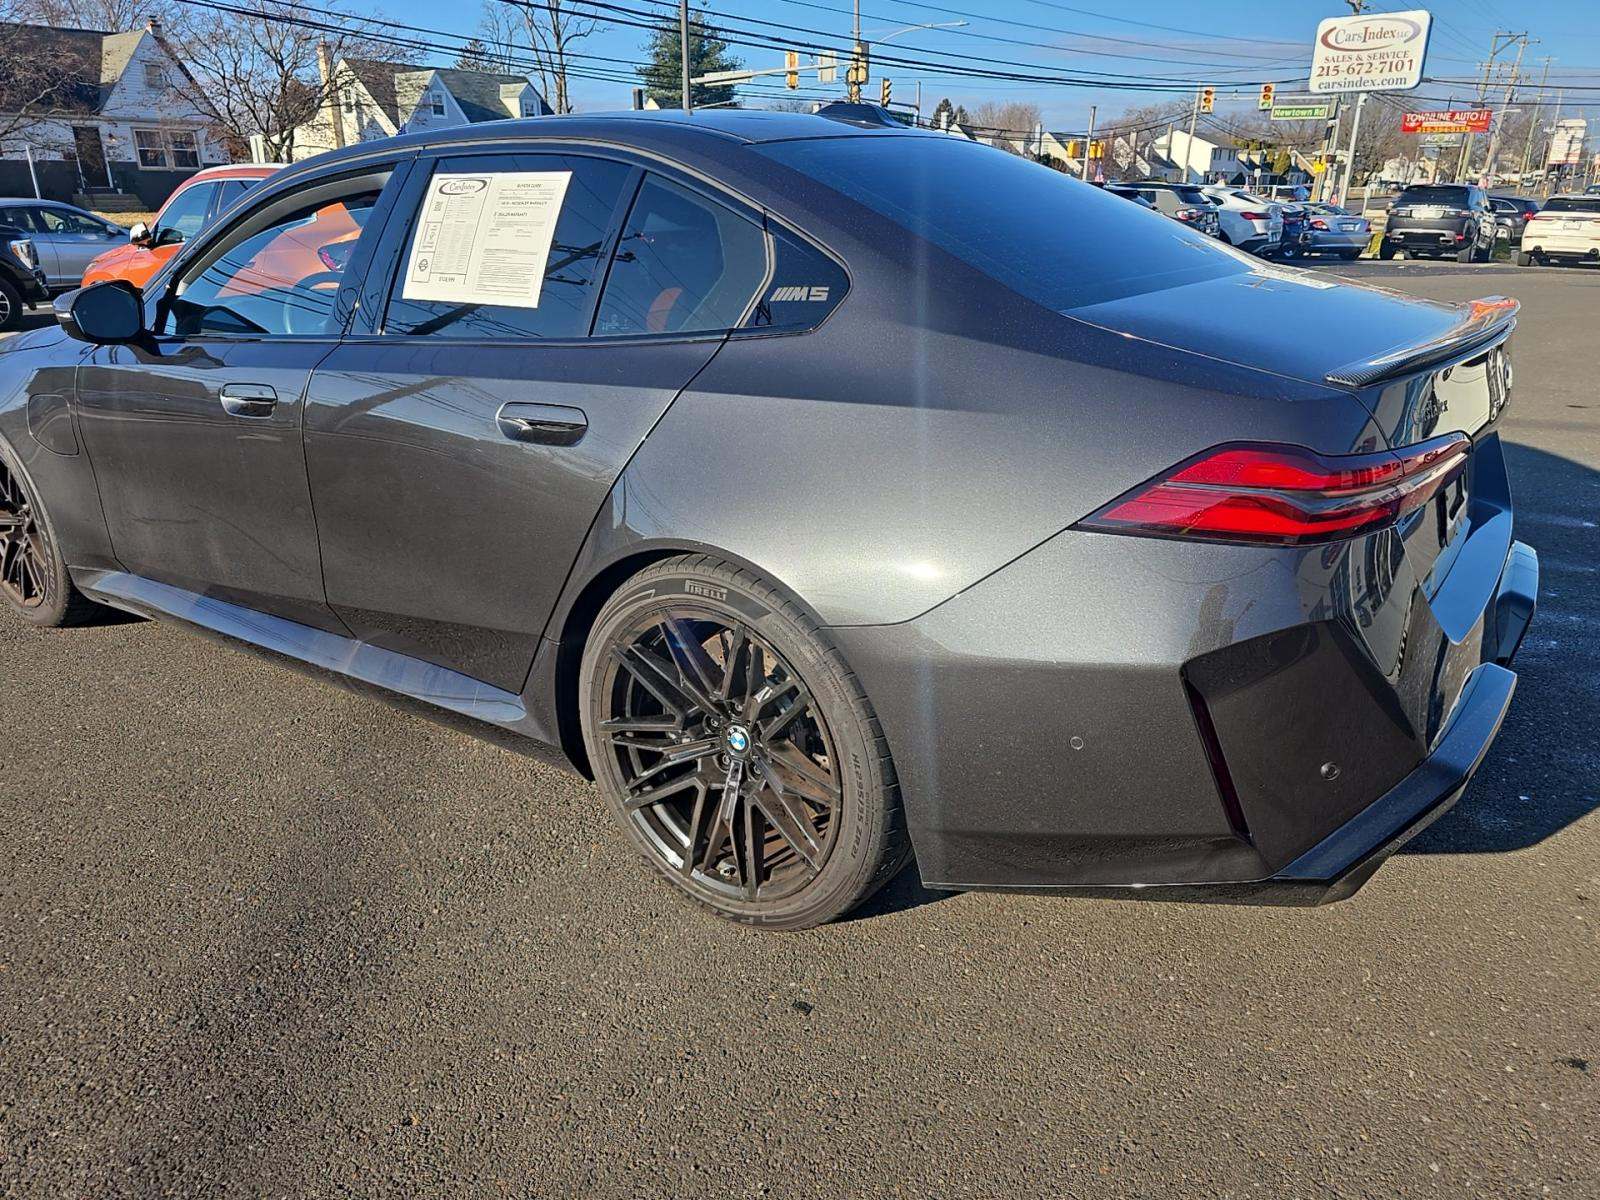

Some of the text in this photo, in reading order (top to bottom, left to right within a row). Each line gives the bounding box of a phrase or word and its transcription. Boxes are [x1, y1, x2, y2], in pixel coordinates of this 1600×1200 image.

[1334, 26, 1396, 44] CarsIndex
[1324, 50, 1410, 64] SALES & SERVICE
[1316, 59, 1414, 77] 215-672-7101
[1318, 76, 1407, 90] carsindex.com
[1274, 108, 1326, 117] Newtown Rd
[1453, 112, 1478, 121] AUTO
[684, 579, 728, 601] PIRELLI
